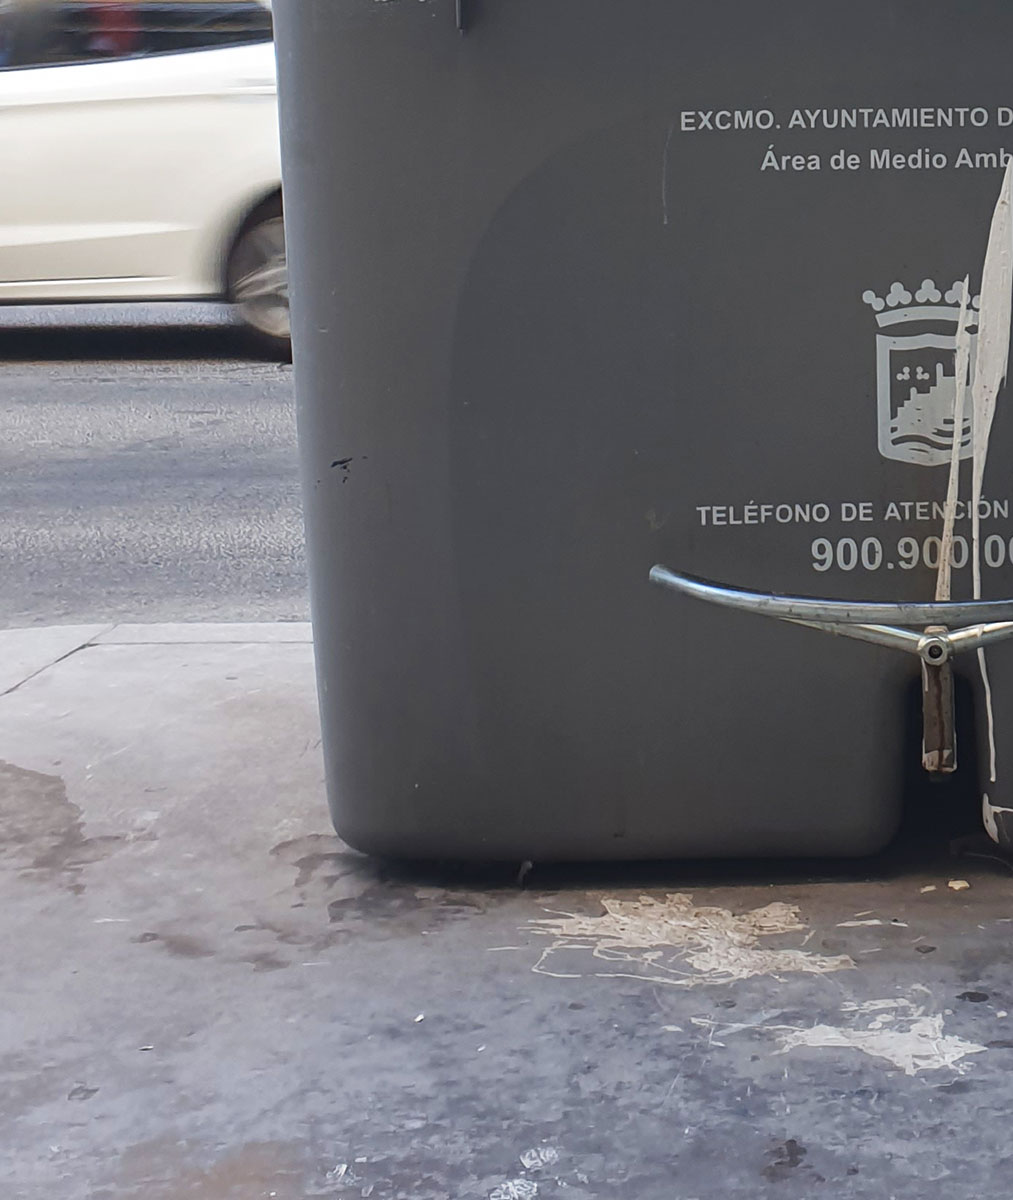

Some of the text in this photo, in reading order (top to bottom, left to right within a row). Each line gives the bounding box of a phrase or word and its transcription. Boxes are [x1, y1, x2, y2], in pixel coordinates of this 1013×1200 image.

[680, 109, 781, 131] EXCMO.
[788, 107, 989, 129] AYUNTAMIENTO
[760, 144, 821, 171] Área
[830, 149, 861, 170] de
[870, 148, 947, 170] Medio
[696, 500, 830, 526] TELÉFONO
[841, 502, 874, 522] DE
[884, 495, 1009, 521] ATENCIÓN
